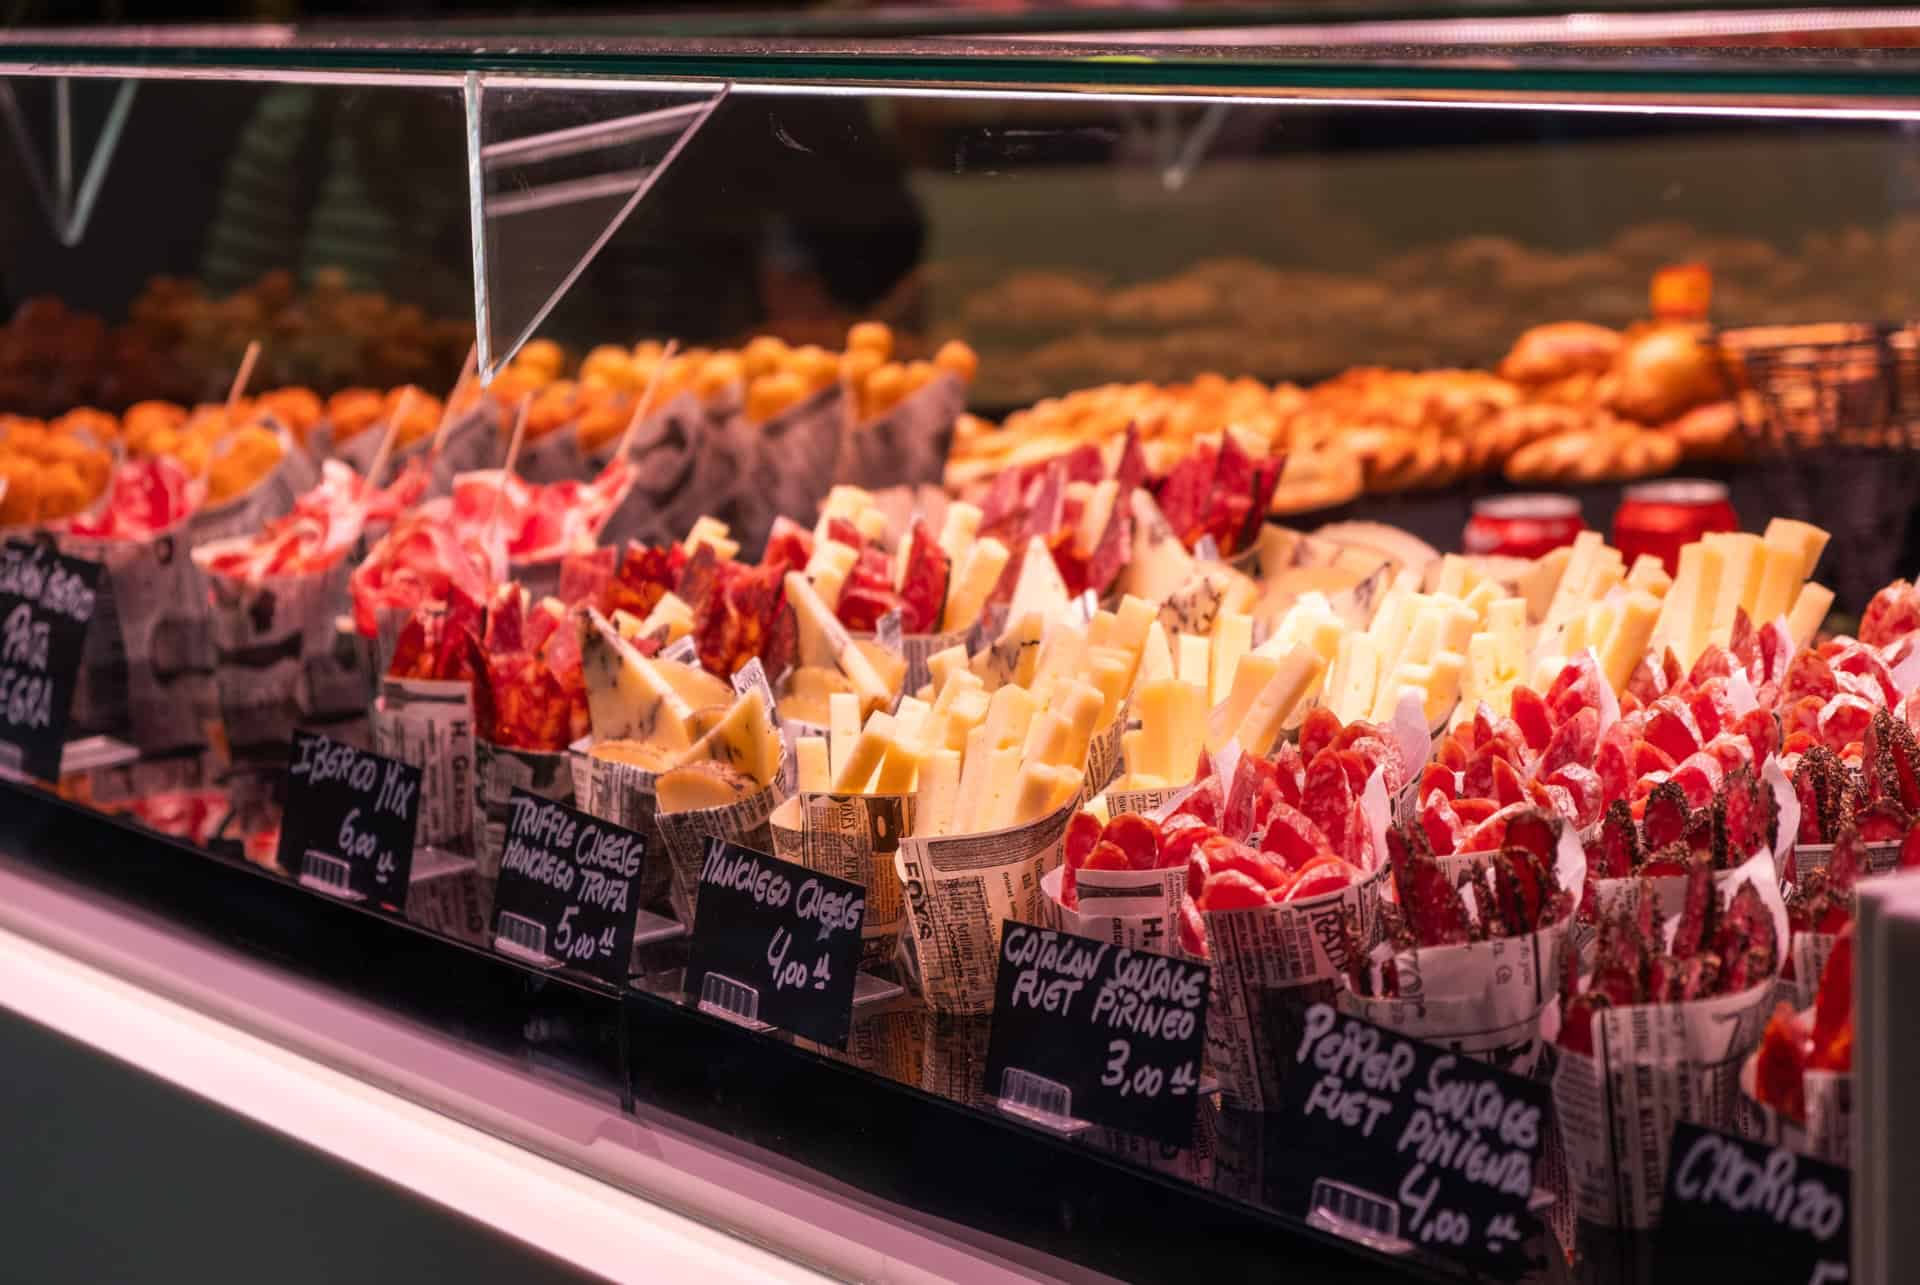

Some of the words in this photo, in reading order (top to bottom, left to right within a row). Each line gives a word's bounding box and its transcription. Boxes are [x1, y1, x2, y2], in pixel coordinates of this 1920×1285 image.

[339, 808, 377, 858] 6,00
[511, 797, 576, 849] TRUFFLE
[575, 825, 644, 878] CHEESE
[502, 839, 575, 892] MANCHEGO
[576, 868, 629, 913] TRUFA
[700, 838, 792, 908] MANCHEGO
[796, 878, 865, 930] CHEESE
[554, 906, 595, 959] 5,00
[767, 926, 808, 991] 4,00
[1004, 928, 1104, 981] CATALAN
[1105, 947, 1205, 1008] SAUSAGE
[1012, 969, 1083, 1017] FUET
[1091, 986, 1196, 1040] PIRINEO
[1101, 1040, 1163, 1097] 3,00
[1296, 1002, 1415, 1093] PEPPER
[1414, 1055, 1542, 1149] SAUSAGE
[1303, 1075, 1393, 1137] FUET
[1399, 1163, 1470, 1245] 4,00
[1675, 1134, 1844, 1240] CHORIZO
